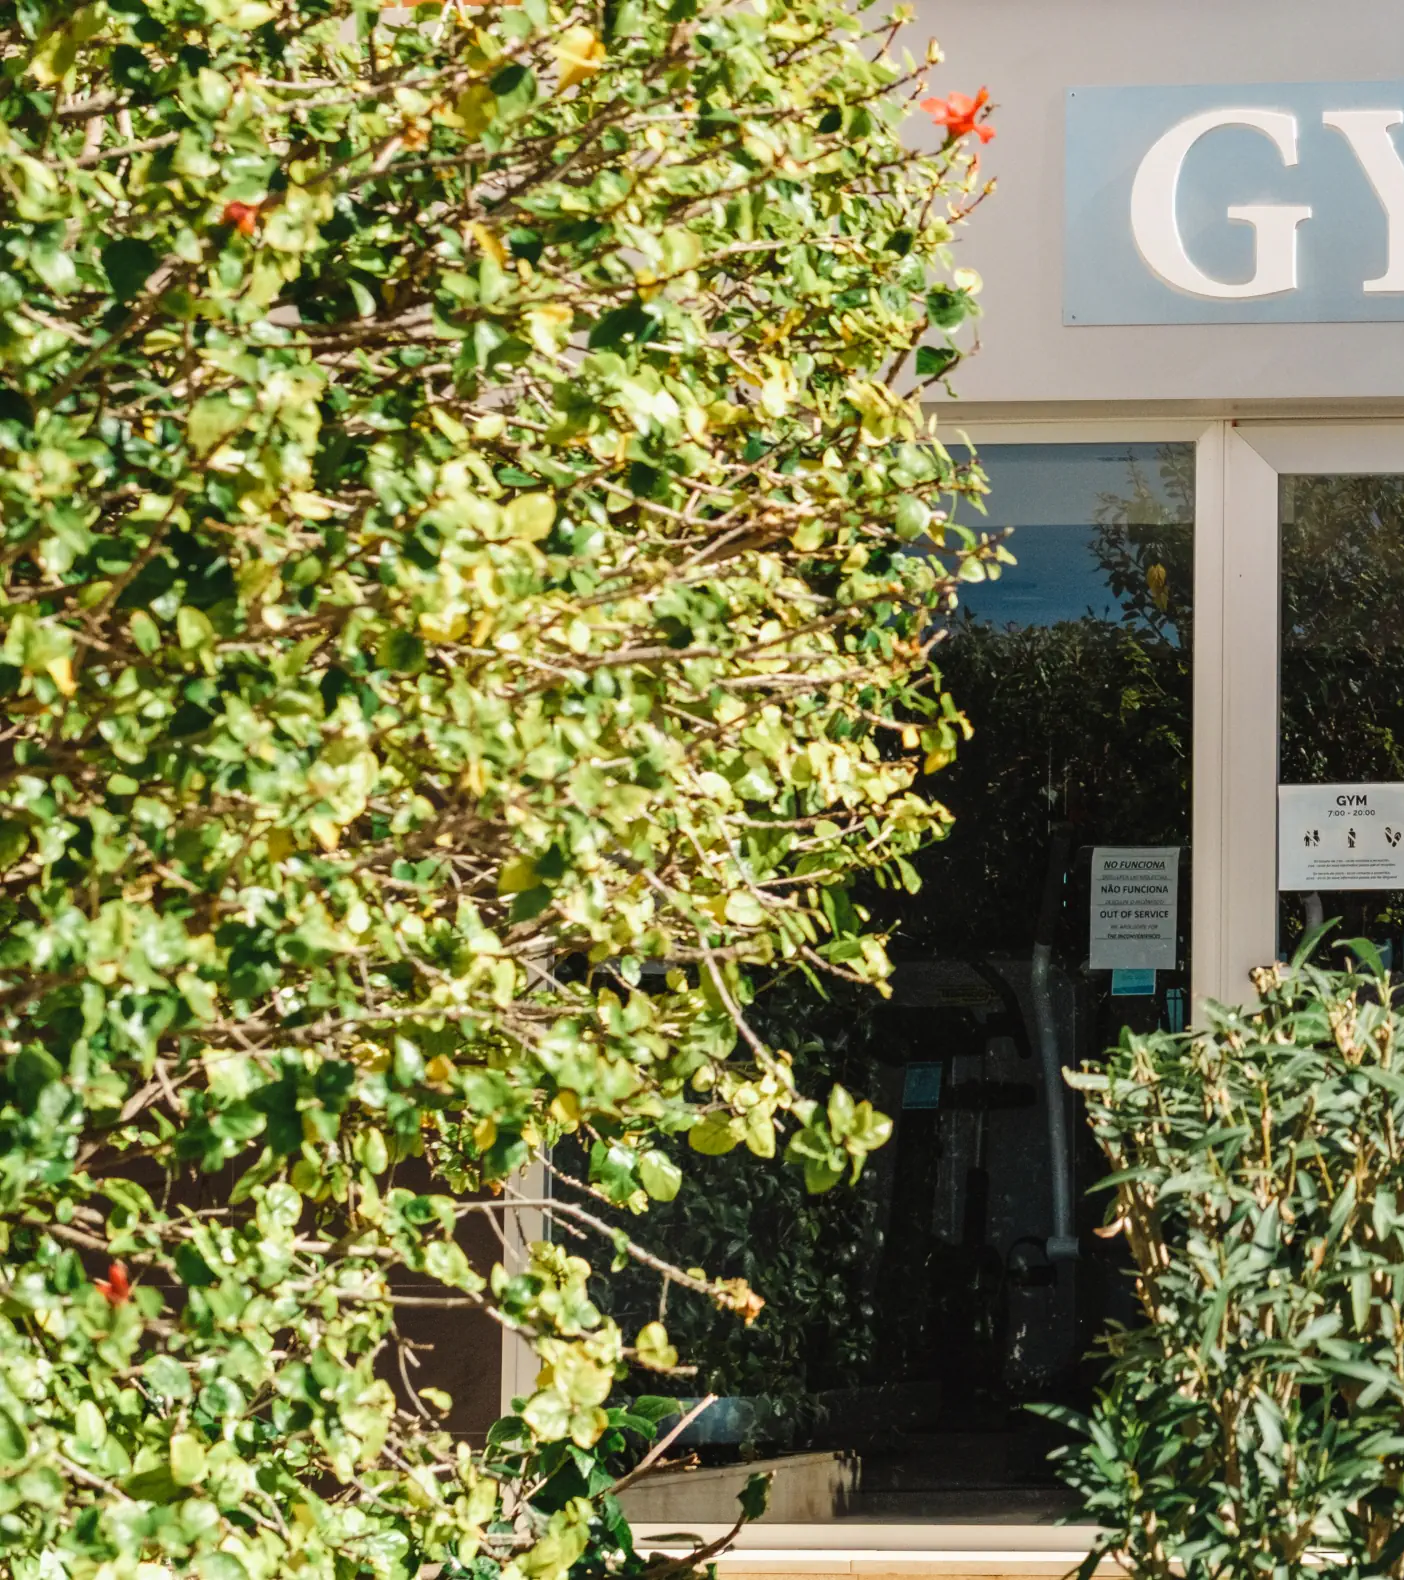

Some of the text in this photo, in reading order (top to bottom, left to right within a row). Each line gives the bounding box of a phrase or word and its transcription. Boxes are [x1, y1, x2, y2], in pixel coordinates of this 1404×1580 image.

[1336, 795, 1367, 806] GYM
[1104, 861, 1165, 869] NO FUNCIONA
[1101, 884, 1168, 893] NÃO FUNCIONA
